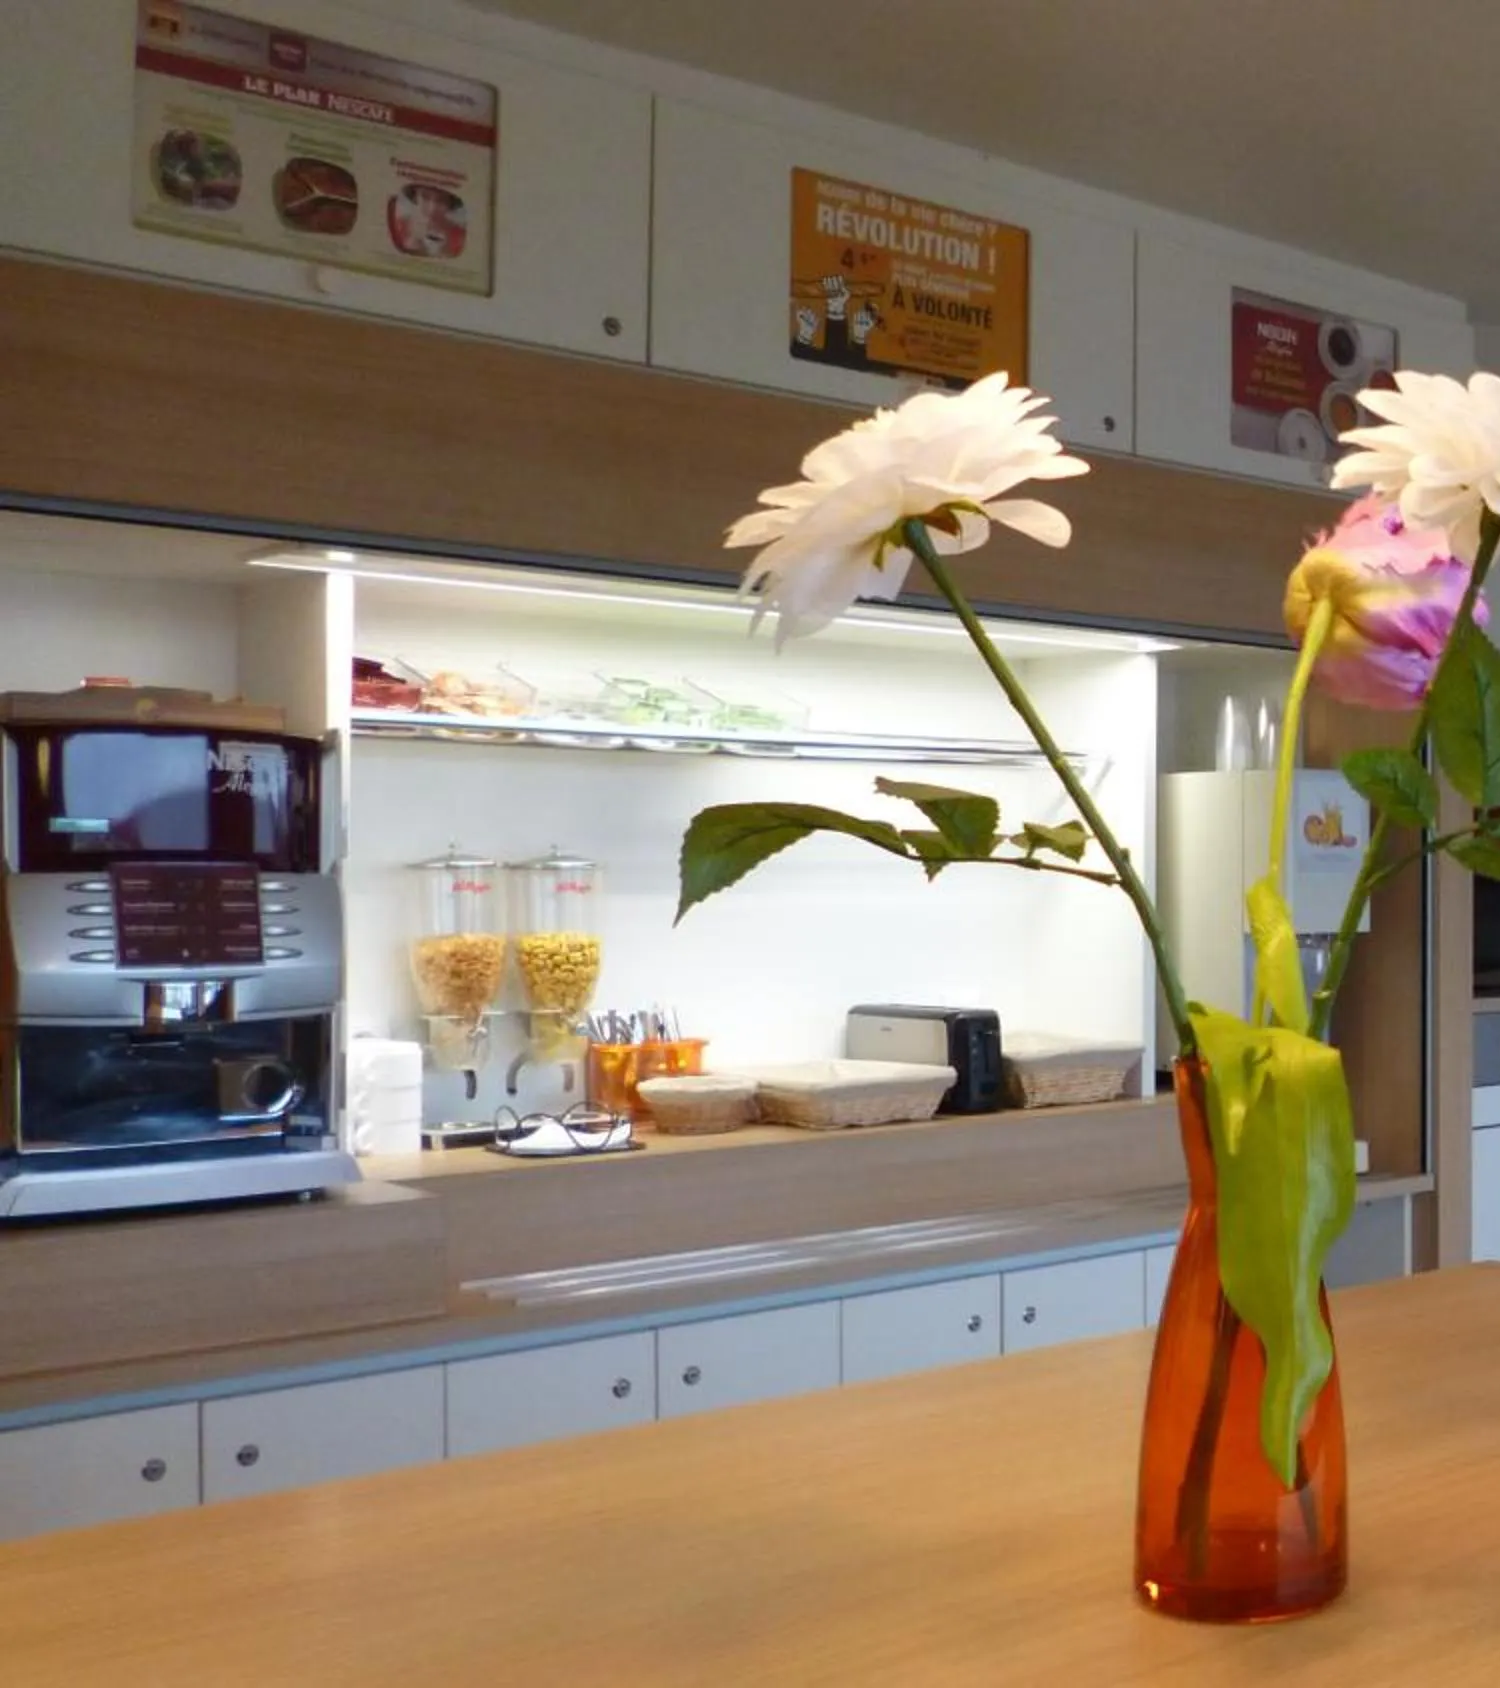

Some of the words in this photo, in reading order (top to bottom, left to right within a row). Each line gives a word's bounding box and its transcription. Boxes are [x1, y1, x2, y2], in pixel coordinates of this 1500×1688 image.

[243, 75, 268, 95] LE
[816, 202, 980, 271] RÉVOLUTION
[912, 291, 993, 330] VOLONTÉ
